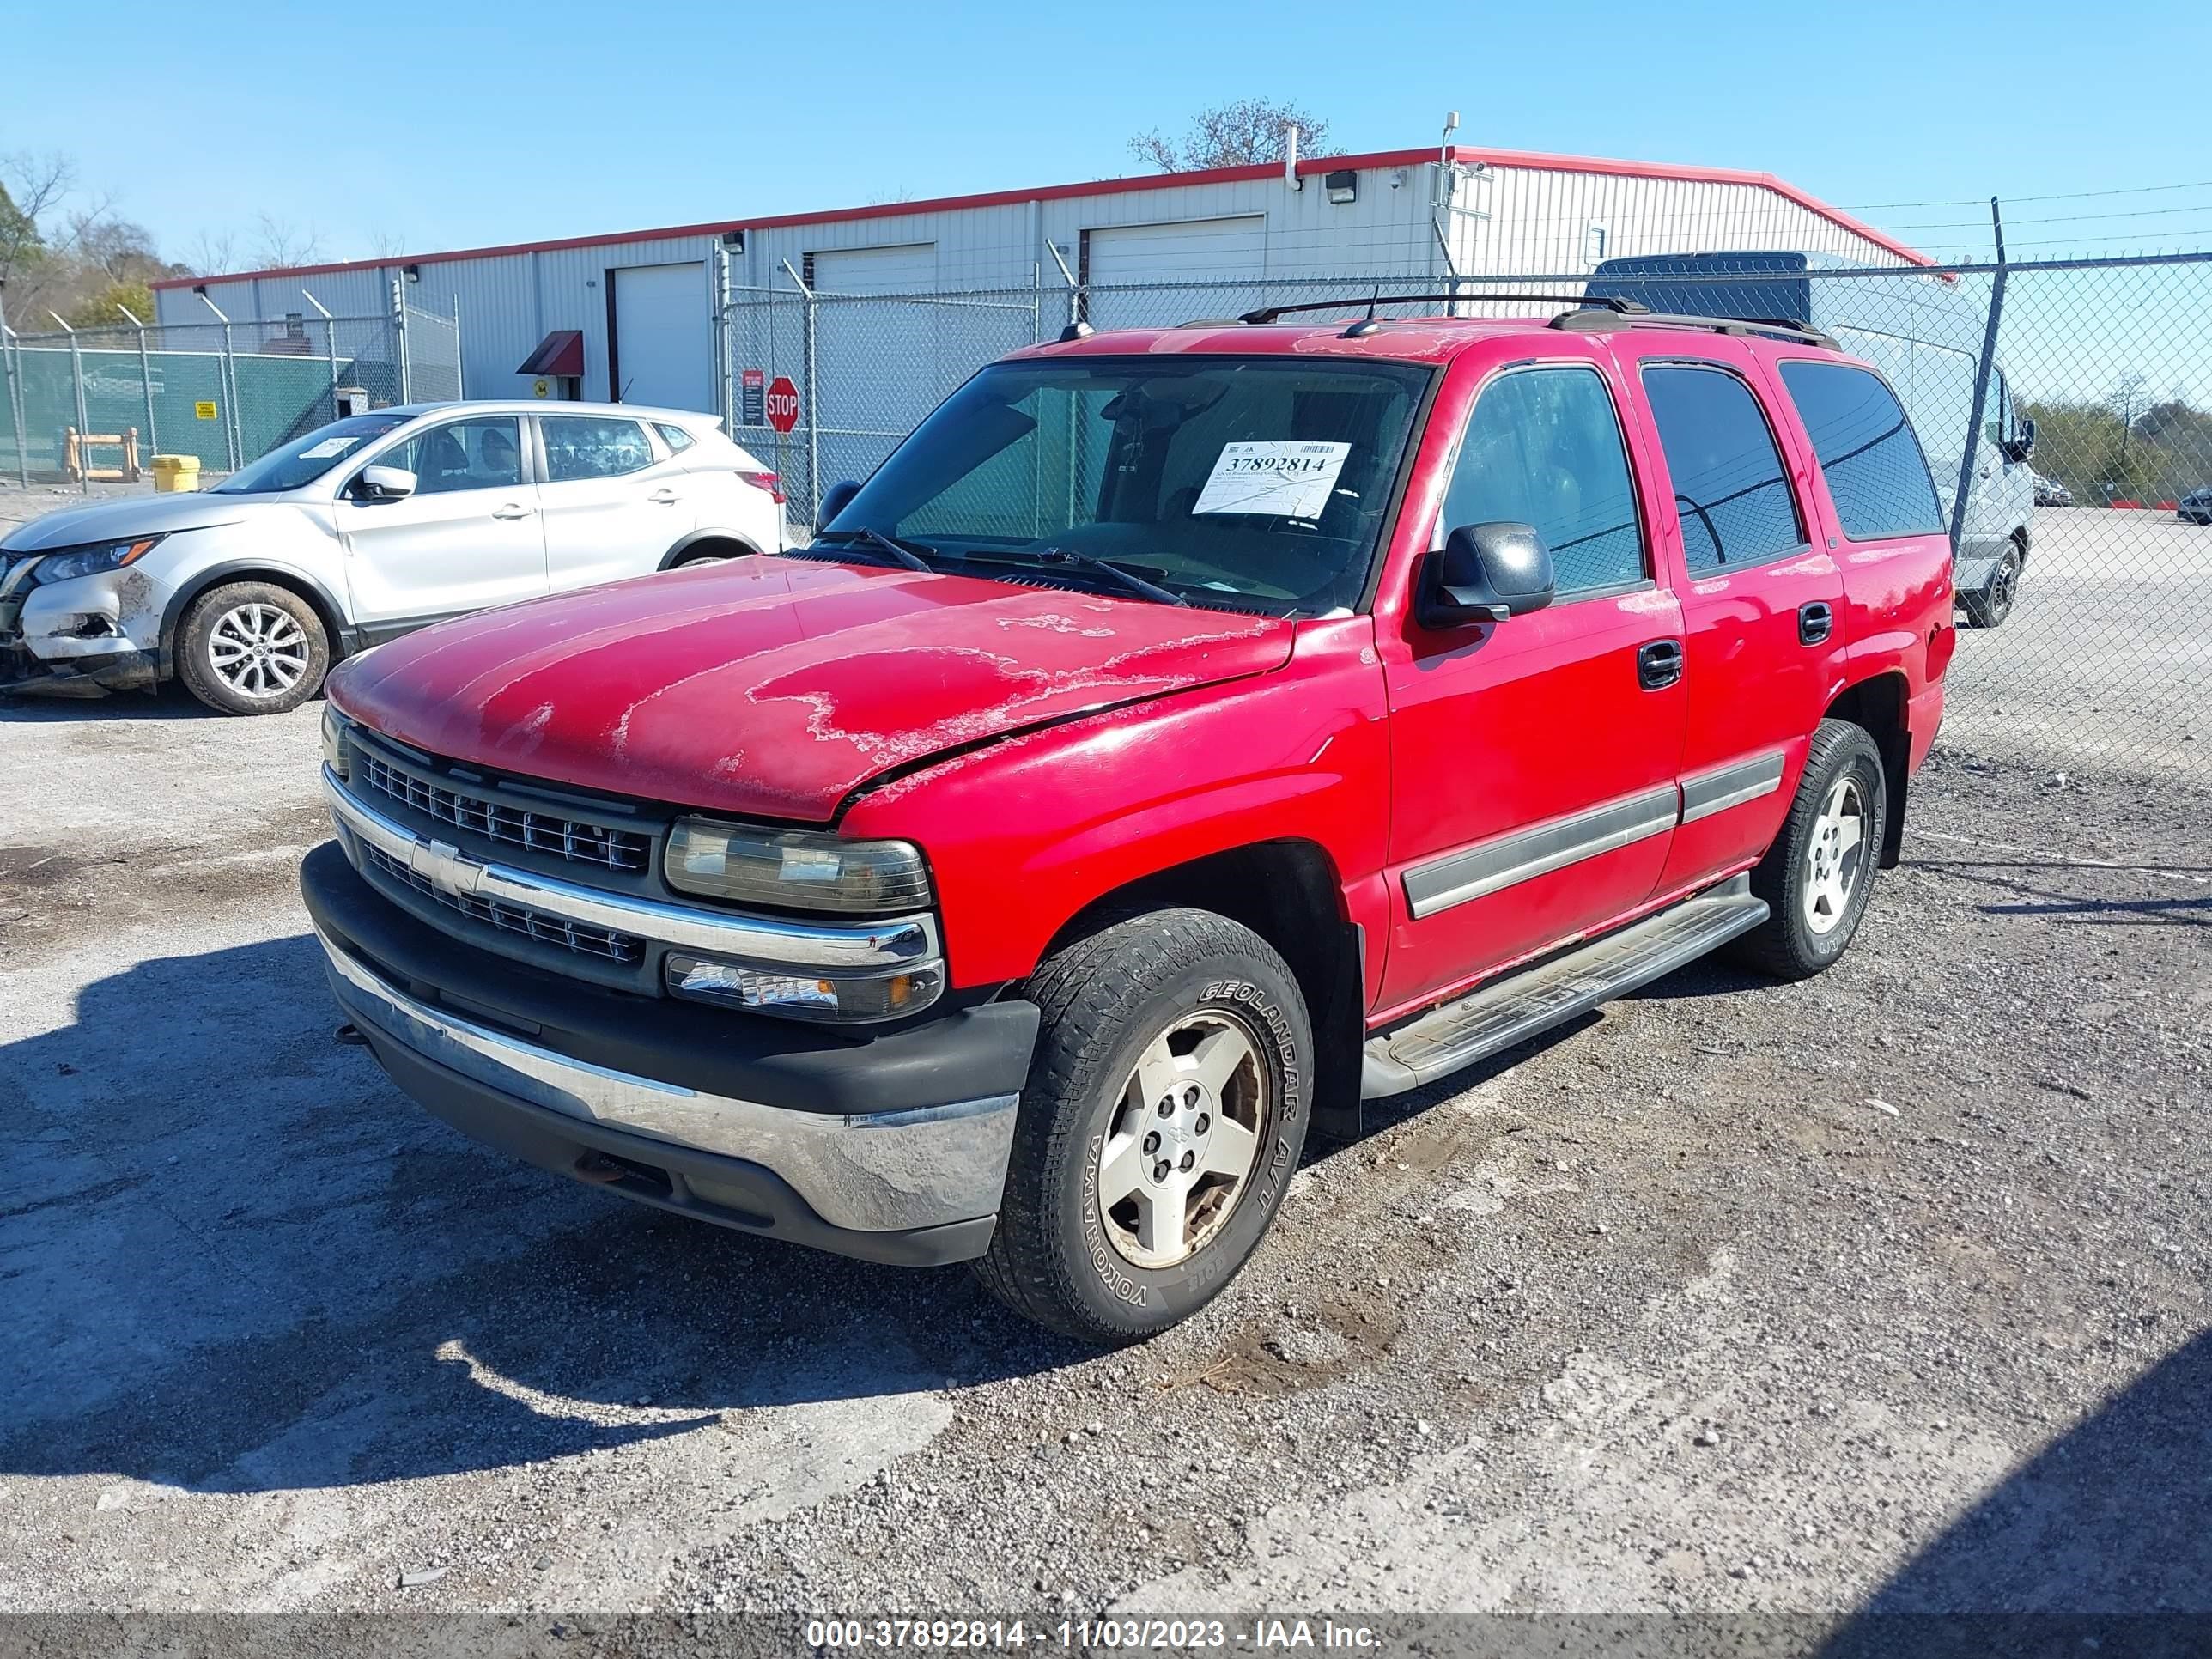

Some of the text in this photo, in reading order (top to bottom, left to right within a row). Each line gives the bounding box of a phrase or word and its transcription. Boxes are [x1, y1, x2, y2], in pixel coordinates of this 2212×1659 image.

[768, 394, 797, 416] STOP
[1225, 457, 1327, 472] 37892814
[1819, 803, 1883, 954] GEOLANDAR A/T
[1199, 980, 1300, 1218] GEOLANDAR A/T
[1083, 1133, 1148, 1308] YOKOHAMA
